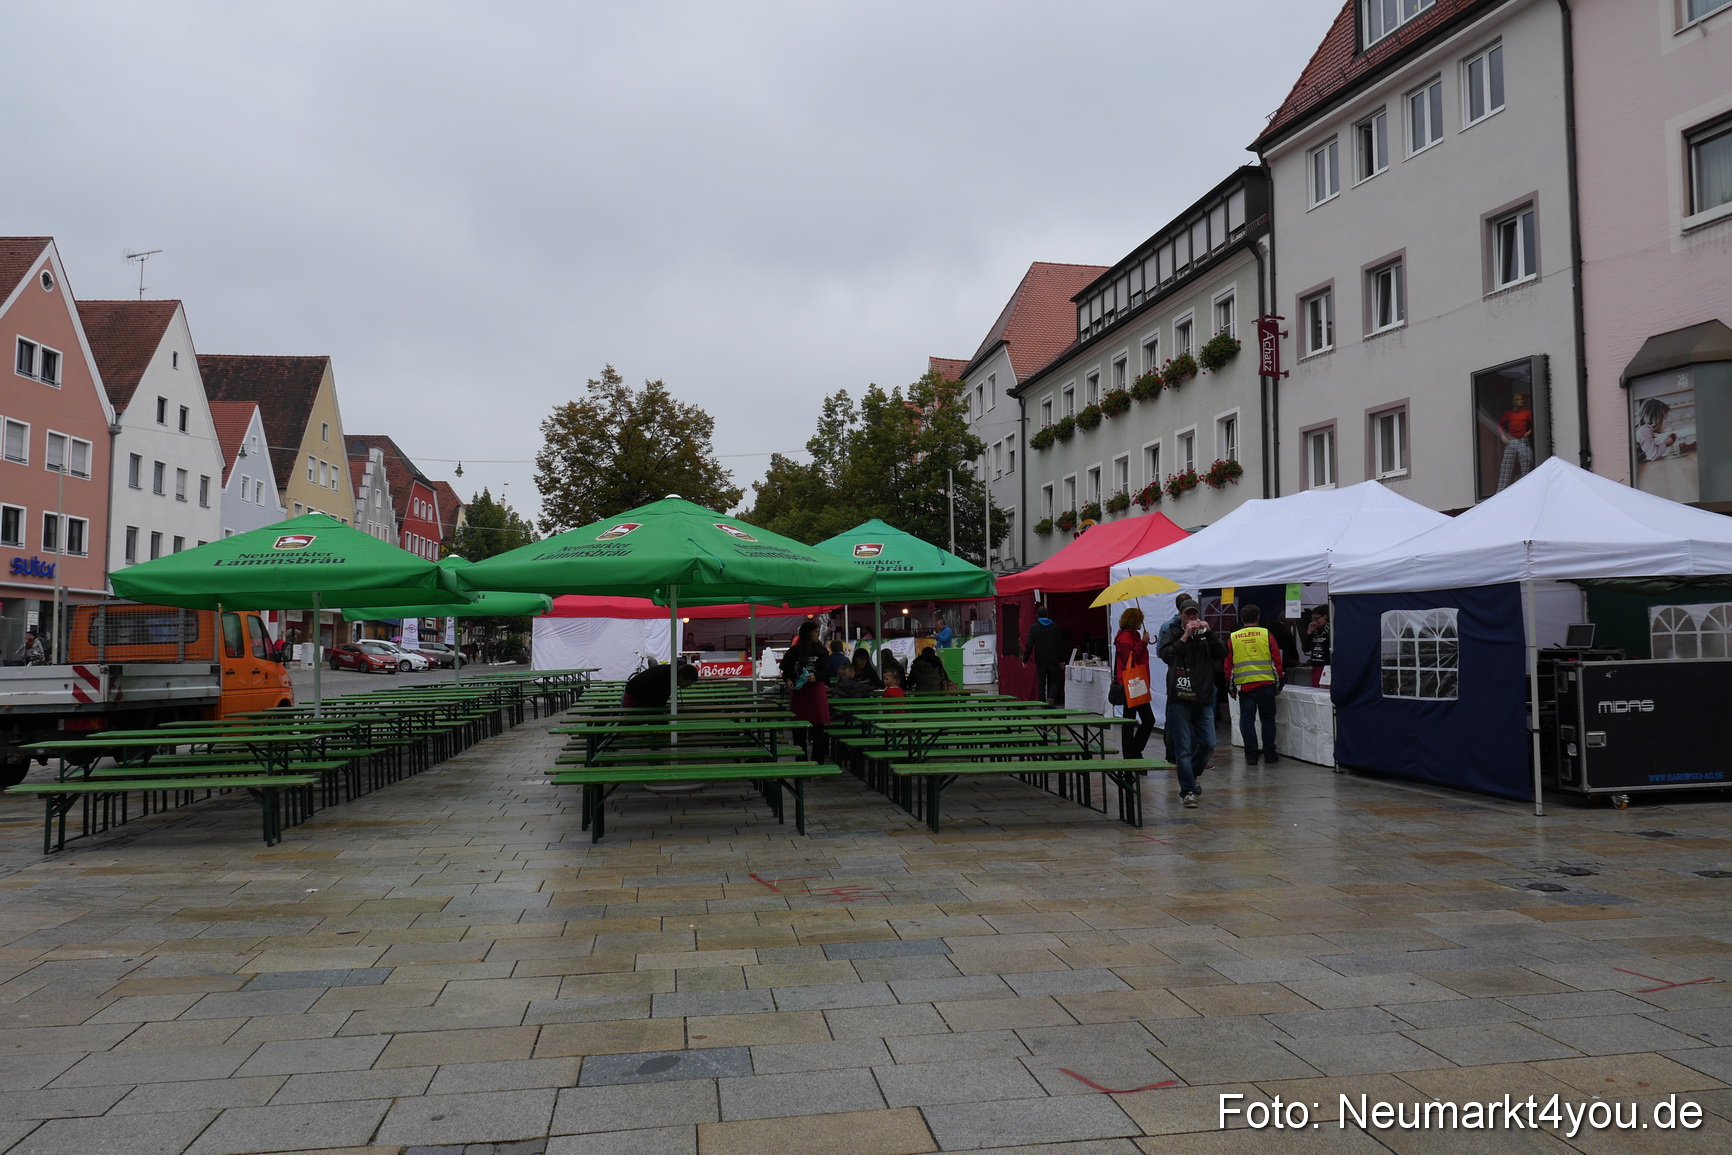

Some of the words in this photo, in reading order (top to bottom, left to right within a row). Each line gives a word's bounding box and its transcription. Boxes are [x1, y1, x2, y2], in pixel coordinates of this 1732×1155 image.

[1262, 329, 1275, 371] Achatz
[559, 543, 632, 552] Neumarkter
[238, 551, 334, 559] Neumarkter
[531, 549, 633, 561] Lammsbräu
[11, 556, 58, 579] sutor
[213, 556, 347, 567] Lammsbräu
[1235, 631, 1261, 639] HELFER
[701, 664, 744, 677] Bögerl
[1598, 699, 1655, 714] MIDAS
